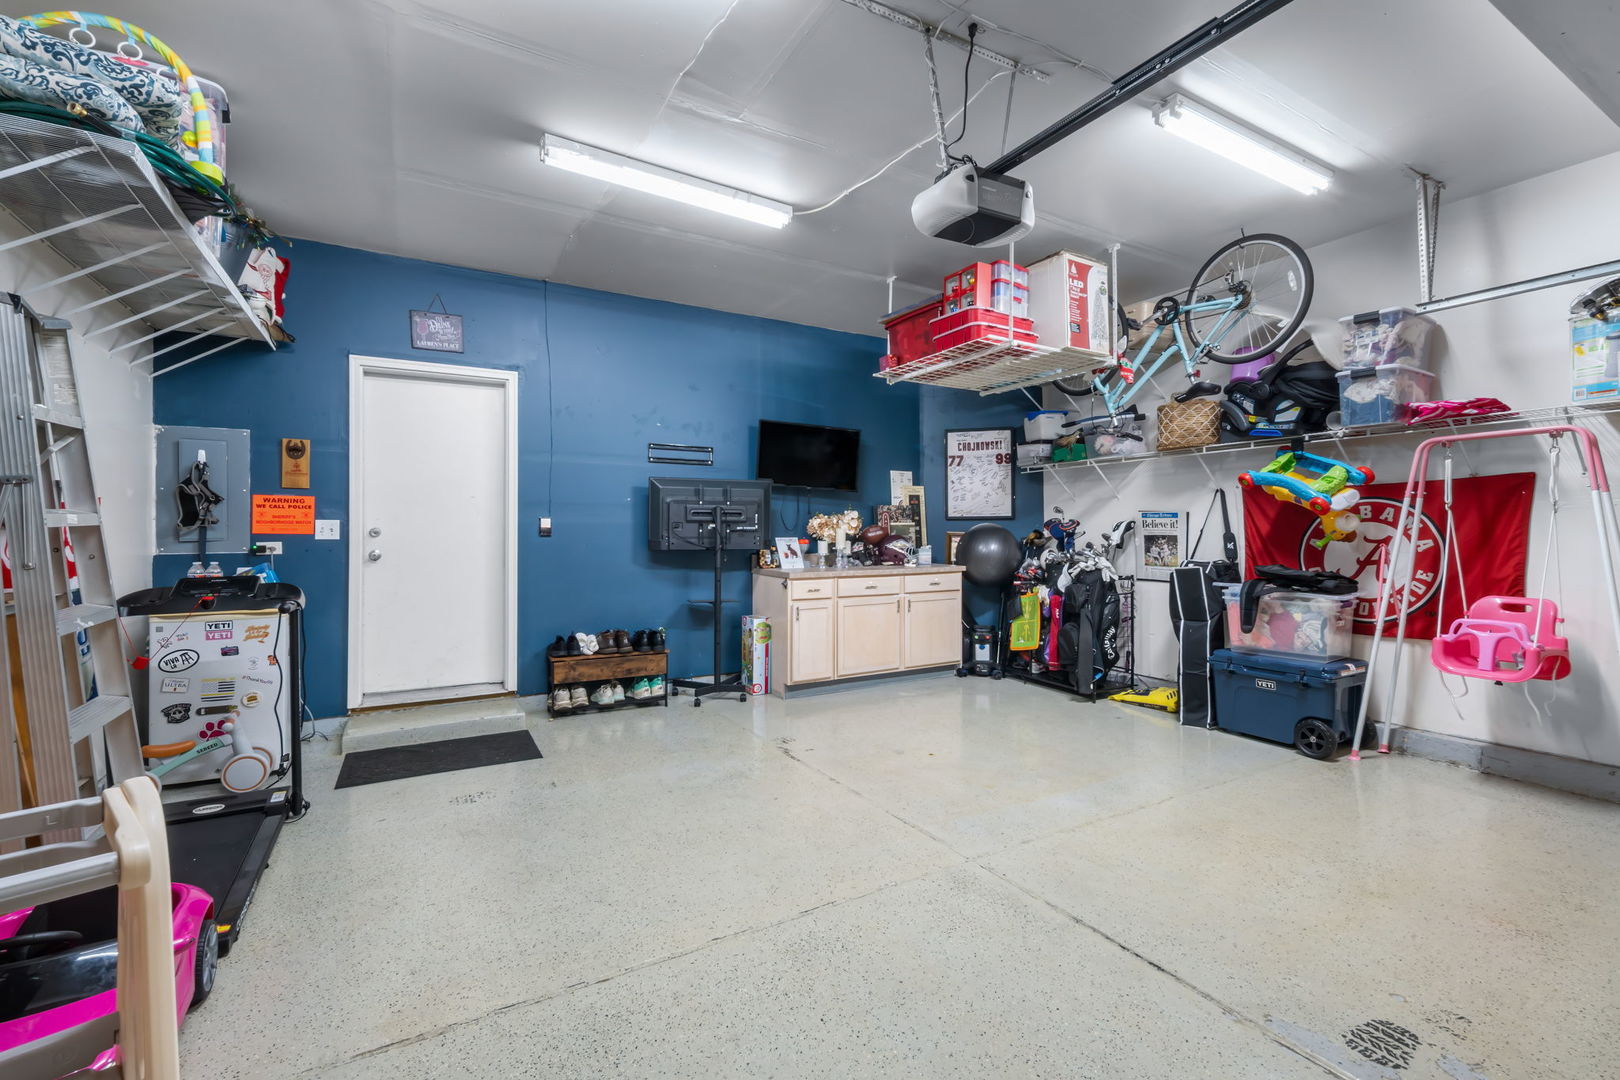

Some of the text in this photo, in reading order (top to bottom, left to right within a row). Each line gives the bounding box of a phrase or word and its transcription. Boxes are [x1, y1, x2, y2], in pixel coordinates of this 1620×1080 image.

[1069, 277, 1084, 289] LED
[948, 455, 964, 467] 77
[995, 453, 1012, 465] 99
[1142, 519, 1179, 529] Believe it!
[206, 622, 231, 630] YETI
[207, 631, 231, 640] YETI
[1103, 625, 1116, 661] Callaway
[163, 656, 180, 667] VIVA
[1257, 680, 1274, 689] YETI
